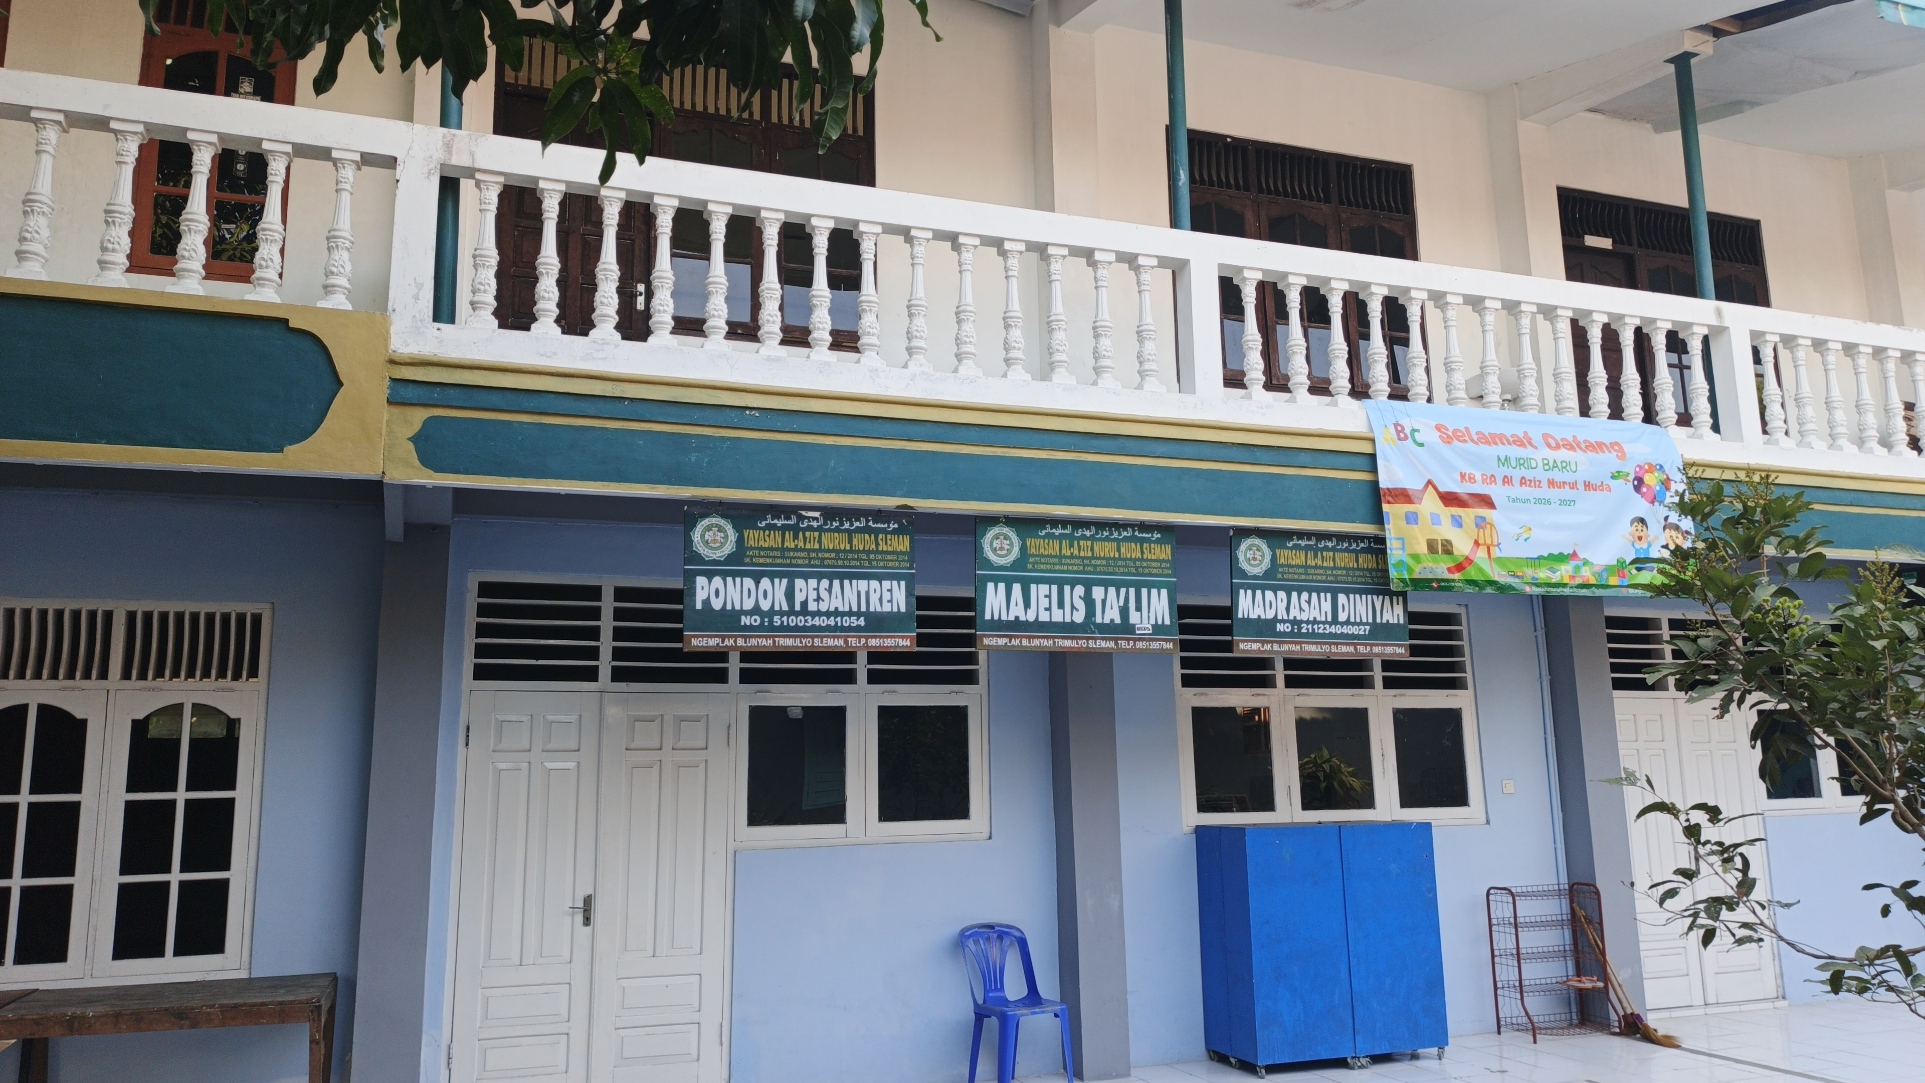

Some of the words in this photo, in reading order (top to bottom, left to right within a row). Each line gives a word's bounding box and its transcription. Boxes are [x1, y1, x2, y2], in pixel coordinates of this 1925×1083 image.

[1434, 423, 1538, 451] Selamat
[1541, 432, 1627, 462] Datang
[1497, 455, 1538, 471] MURID
[1541, 457, 1578, 473] BARU
[1459, 471, 1477, 485] KB
[1481, 473, 1498, 486] RA
[1501, 474, 1515, 487] Al
[1519, 476, 1543, 489] Aziz
[1547, 478, 1580, 492] Nurul
[1583, 480, 1612, 493] Huda
[1506, 495, 1532, 505] Tahun
[1532, 497, 1552, 506] 2026
[1558, 498, 1576, 507] 2027
[743, 529, 782, 548] YAYASAN
[821, 532, 851, 550] NURUL
[852, 533, 876, 551] HUDA
[878, 533, 910, 552] SLEMAN
[1026, 537, 1060, 556] YAYASAN
[1093, 540, 1119, 558] NURUL
[1120, 541, 1142, 559] HUDA
[1143, 542, 1172, 560] SLEMAN
[1275, 548, 1306, 566] YAYASAN
[1335, 551, 1358, 569] NURUL
[1358, 553, 1377, 569] HUDA
[695, 576, 789, 611] PONDOK
[794, 578, 906, 612] PESANTREN
[985, 582, 1086, 624] MAJELIS
[1238, 588, 1332, 622] MADRASAH
[1337, 593, 1404, 624] DINIYAH
[741, 615, 761, 626] NO
[773, 615, 866, 627] 510034041054
[1276, 622, 1292, 632] NO
[1301, 623, 1371, 635] 211234040027
[691, 637, 735, 647] NGEMPLAK
[737, 637, 773, 647] BLUNYAH
[774, 637, 812, 647] TRIMULYO
[814, 637, 846, 648] SLEMAN,
[847, 638, 867, 647] TELP.
[983, 637, 1020, 646] NGEMPLAK
[1022, 638, 1053, 647] BLUNYAH
[1054, 639, 1087, 648] TRIMULYO
[1088, 640, 1117, 650] SLEMAN,
[1118, 640, 1135, 649] TELP.
[1239, 642, 1272, 651] NGEMPLAK
[1273, 643, 1300, 652] BLUNYAH
[1356, 645, 1372, 654] TELP.
